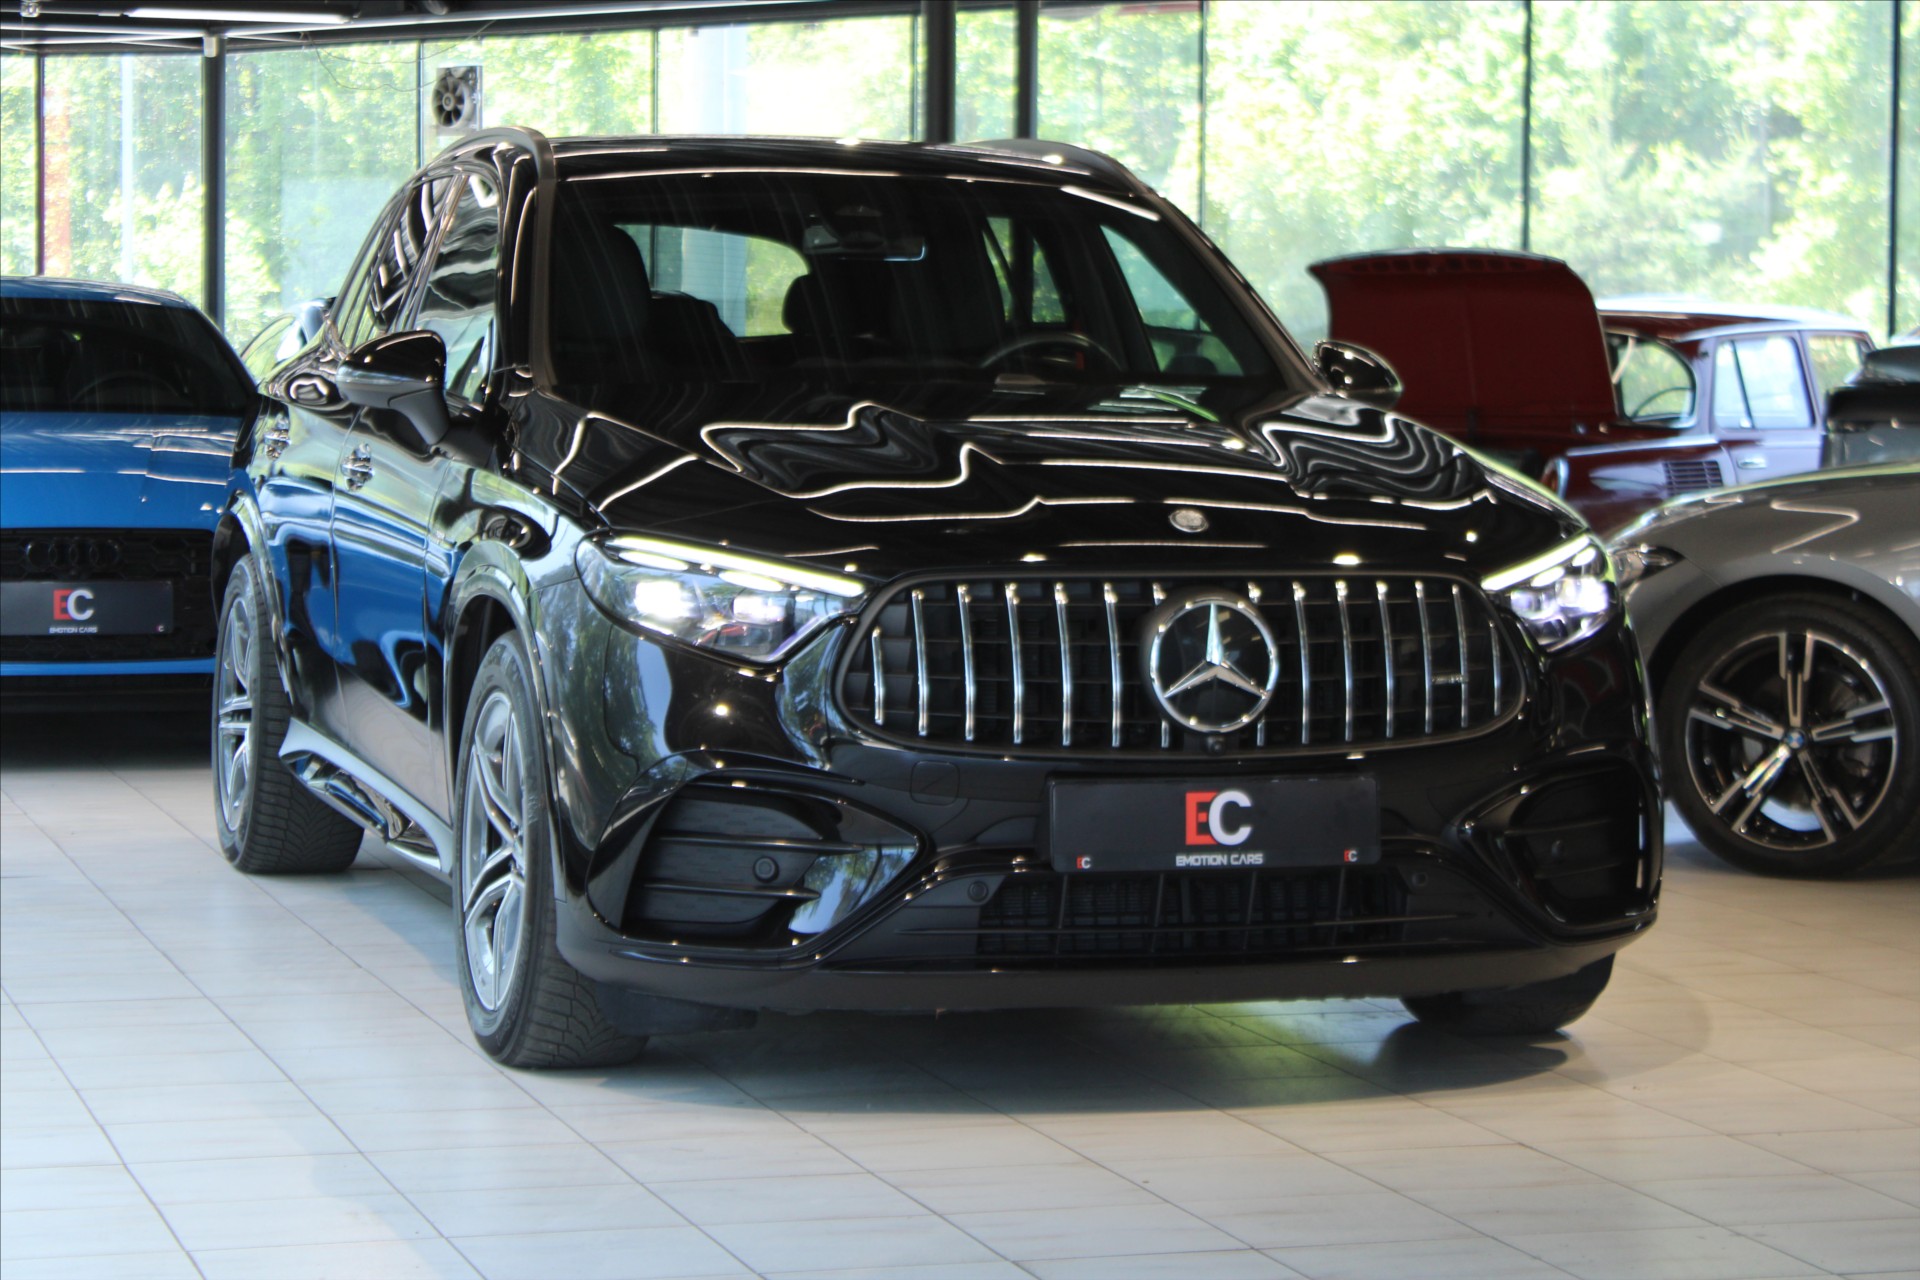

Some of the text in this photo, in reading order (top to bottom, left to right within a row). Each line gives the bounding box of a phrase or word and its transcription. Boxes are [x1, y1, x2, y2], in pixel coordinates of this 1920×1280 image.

[53, 589, 94, 621] EC
[1185, 790, 1252, 846] EC
[1175, 853, 1264, 867] EMOTION CARS
